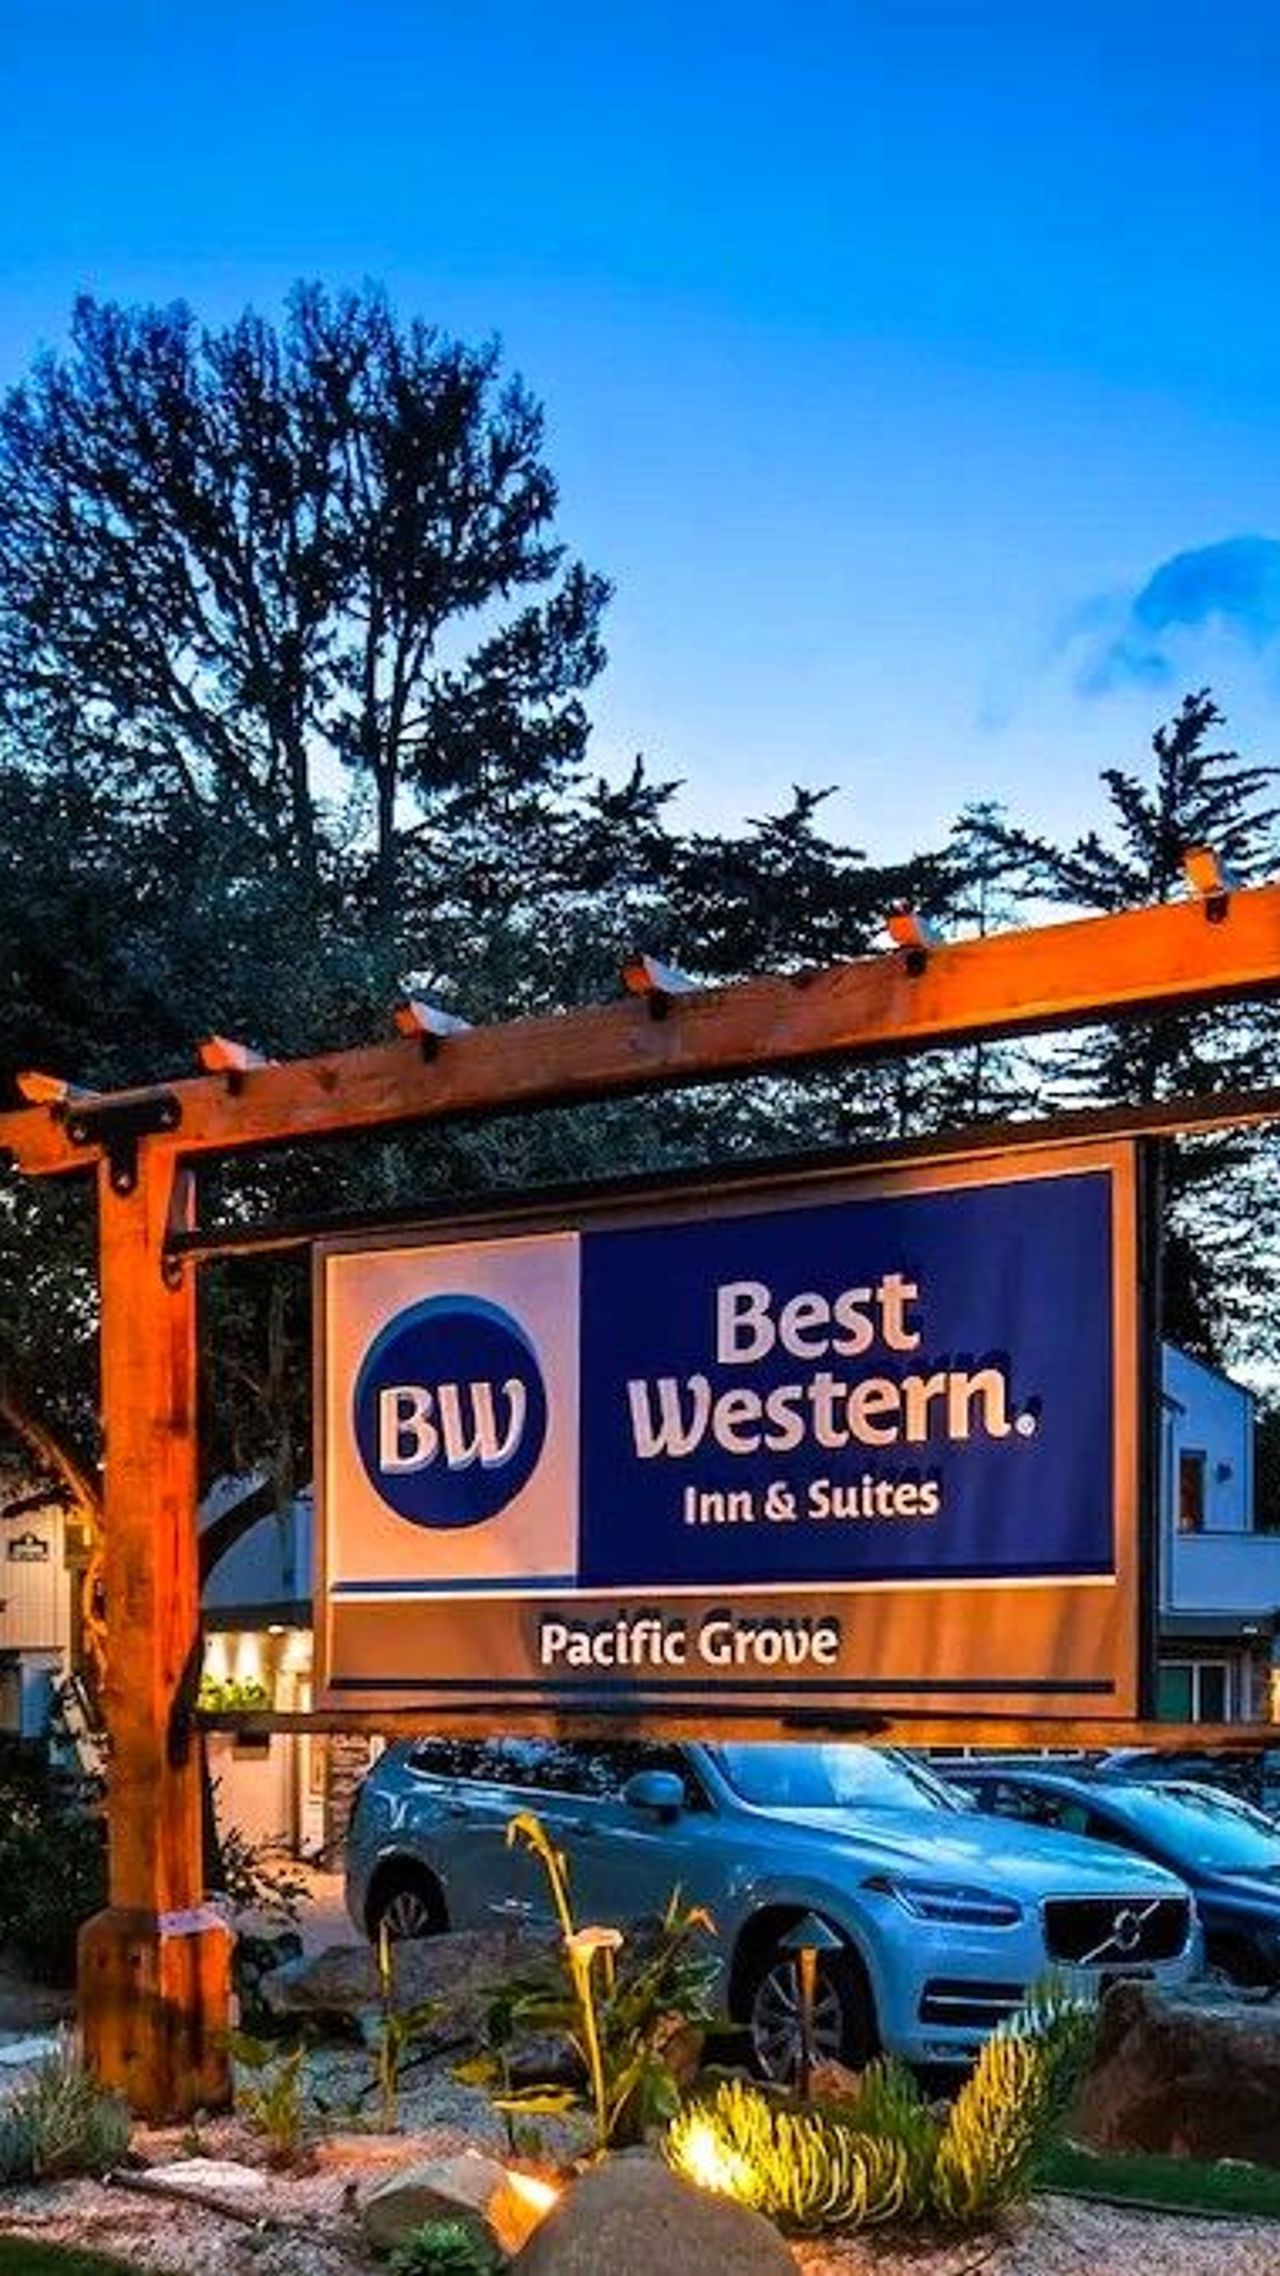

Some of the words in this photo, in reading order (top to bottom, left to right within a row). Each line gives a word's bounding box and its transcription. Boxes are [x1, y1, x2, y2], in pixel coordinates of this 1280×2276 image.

[716, 1273, 921, 1364] Best
[379, 1378, 527, 1475] BW
[684, 1485, 754, 1526] Inn
[764, 1482, 798, 1522] &
[807, 1474, 941, 1520] Suites
[540, 1620, 686, 1665] Pacific
[698, 1620, 839, 1665] Grove
